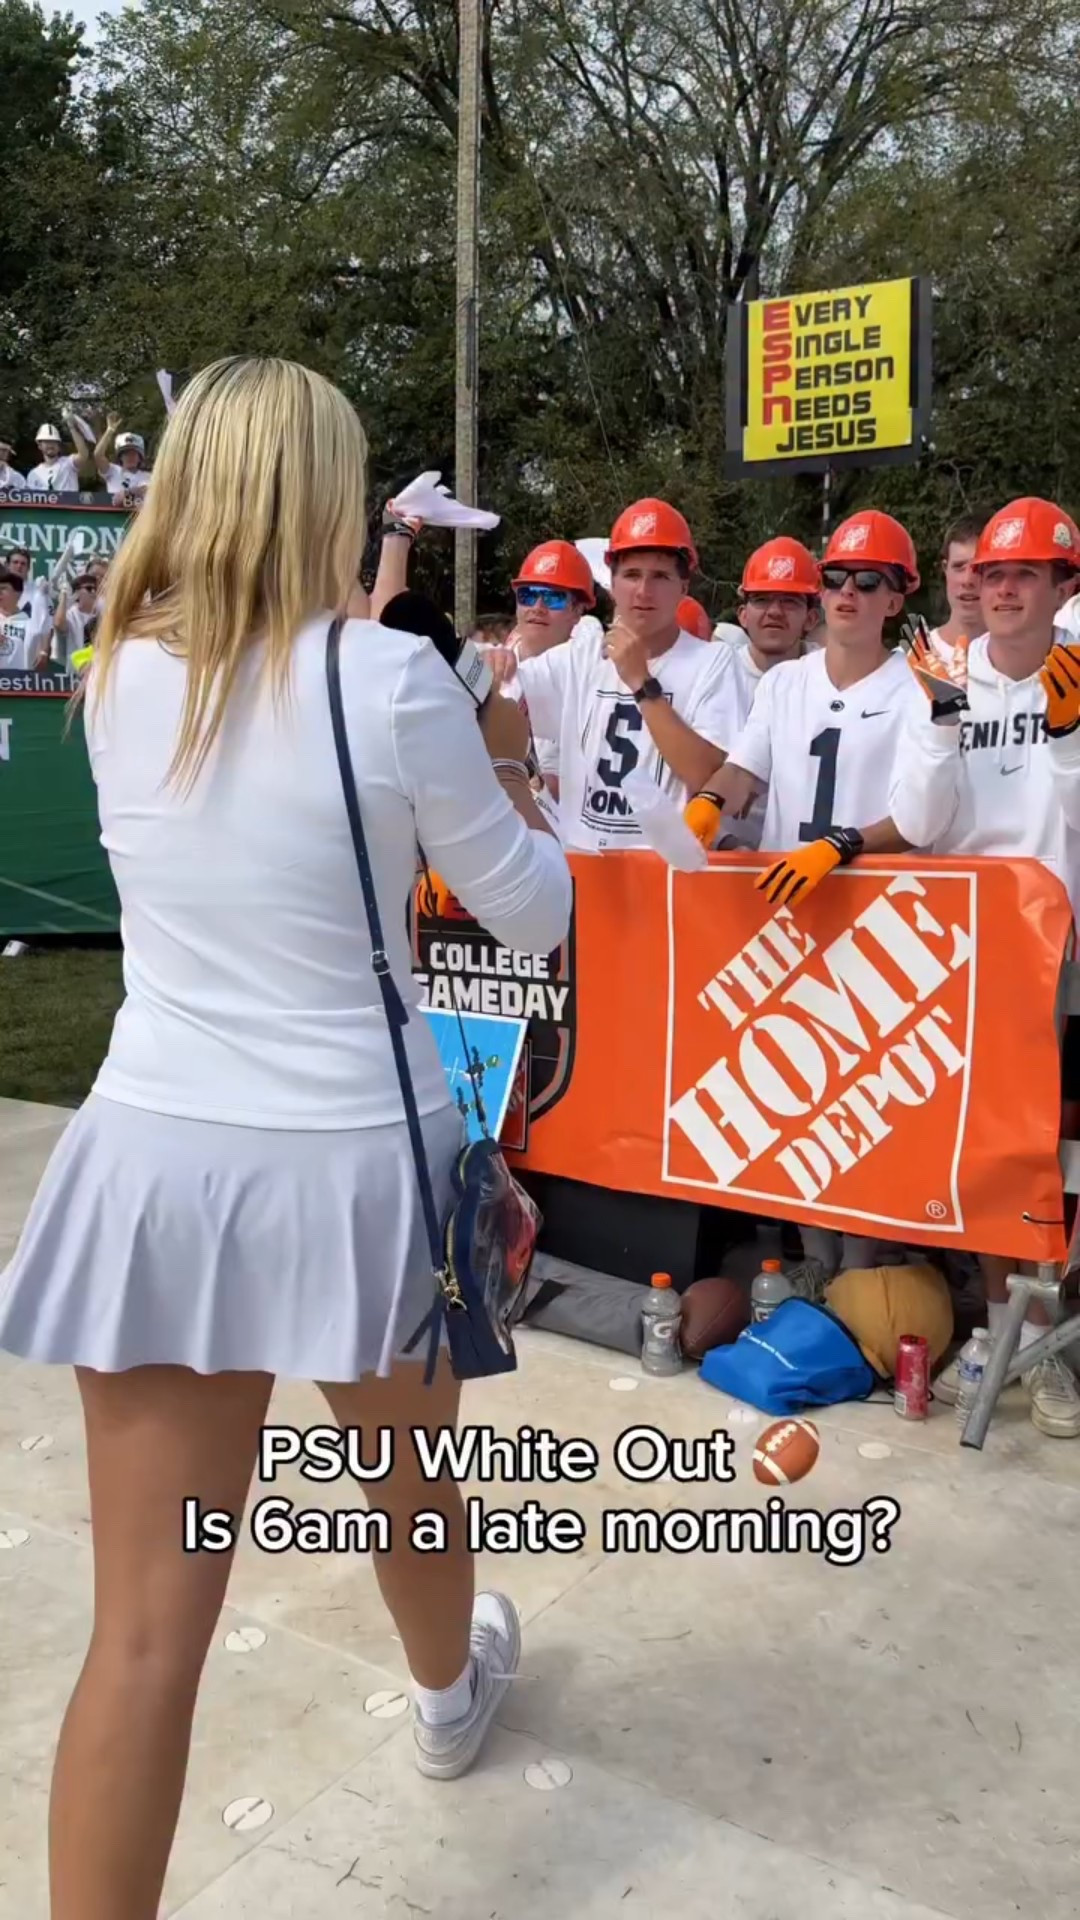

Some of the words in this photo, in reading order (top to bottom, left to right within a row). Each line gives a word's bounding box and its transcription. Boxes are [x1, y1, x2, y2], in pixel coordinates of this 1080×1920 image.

[763, 294, 872, 332] EVERY
[762, 325, 881, 364] SINGLE
[763, 356, 894, 394] PERSON
[763, 391, 871, 425] NEEDS
[776, 418, 876, 452] JESUS
[799, 727, 841, 842] 1
[429, 941, 550, 980] COLLEGE
[697, 905, 817, 1031] THE
[667, 874, 974, 1188] HOME
[774, 1004, 966, 1202] DEPOT
